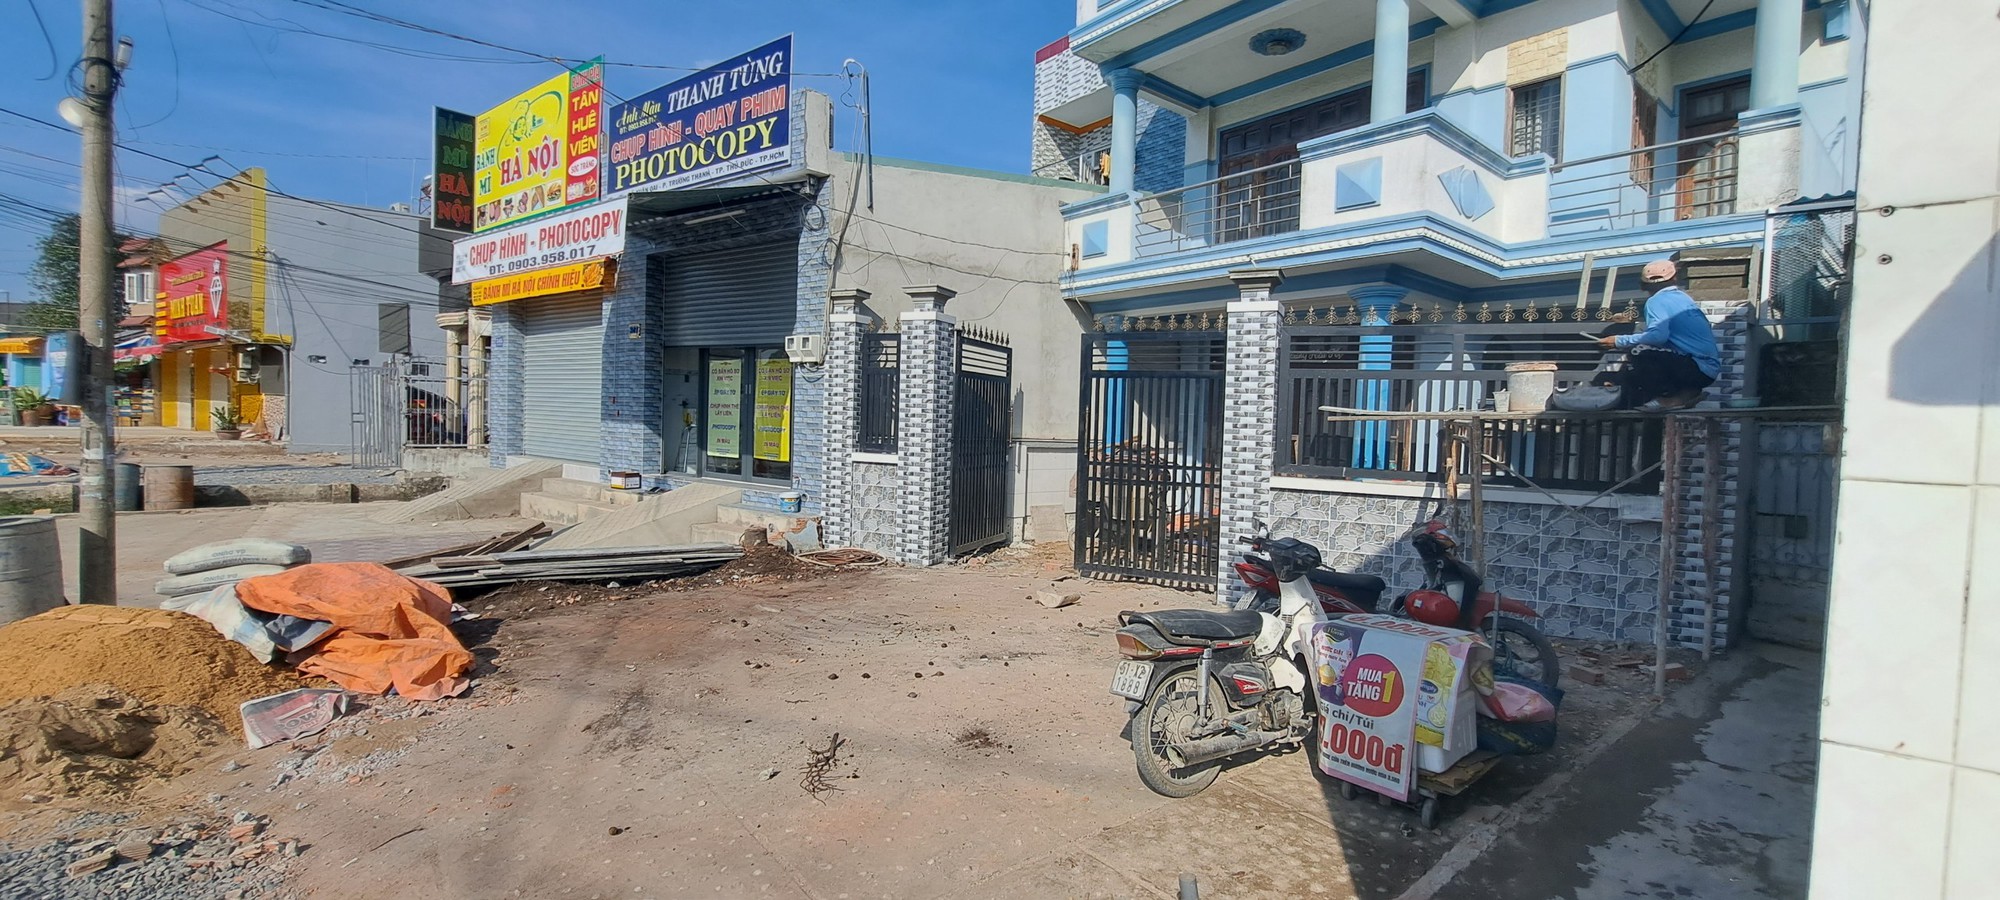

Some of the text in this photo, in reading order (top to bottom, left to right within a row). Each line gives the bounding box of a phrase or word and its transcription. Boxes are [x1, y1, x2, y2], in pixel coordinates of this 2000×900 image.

[668, 51, 783, 114] THANH TÙNG
[572, 89, 599, 112] TÂN
[439, 114, 473, 142] BÁNH
[572, 109, 596, 135] HUÊ
[611, 133, 646, 166] CHỤP
[649, 120, 682, 153] HÌNH
[695, 101, 737, 138] QUAY
[741, 84, 786, 122] PHIM
[443, 145, 468, 168] MÌ
[569, 134, 598, 157] VIÊN
[615, 117, 778, 190] PHOTOCOPY
[501, 135, 559, 185] HÀ NỘI
[439, 172, 470, 197] HÀ
[479, 172, 491, 195] MÌ
[437, 198, 471, 227] NỘI
[469, 241, 497, 268] CHỤP
[499, 233, 528, 260] HÌNH
[538, 209, 624, 251] PHOTOCOPY
[489, 244, 597, 275] ĐT: 0903.958.017
[483, 284, 501, 300] BÁNH
[502, 281, 511, 297] MÌ
[512, 279, 520, 295] HÀ
[523, 276, 535, 295] NỘI
[537, 273, 560, 291] CHÍNH
[562, 269, 581, 289] HIỆU
[1116, 676, 1140, 694] 1888
[1347, 681, 1381, 701] TẶNG
[1382, 670, 1396, 703] 1
[1357, 667, 1383, 683] MUA
[1332, 709, 1374, 730] chi/Túi
